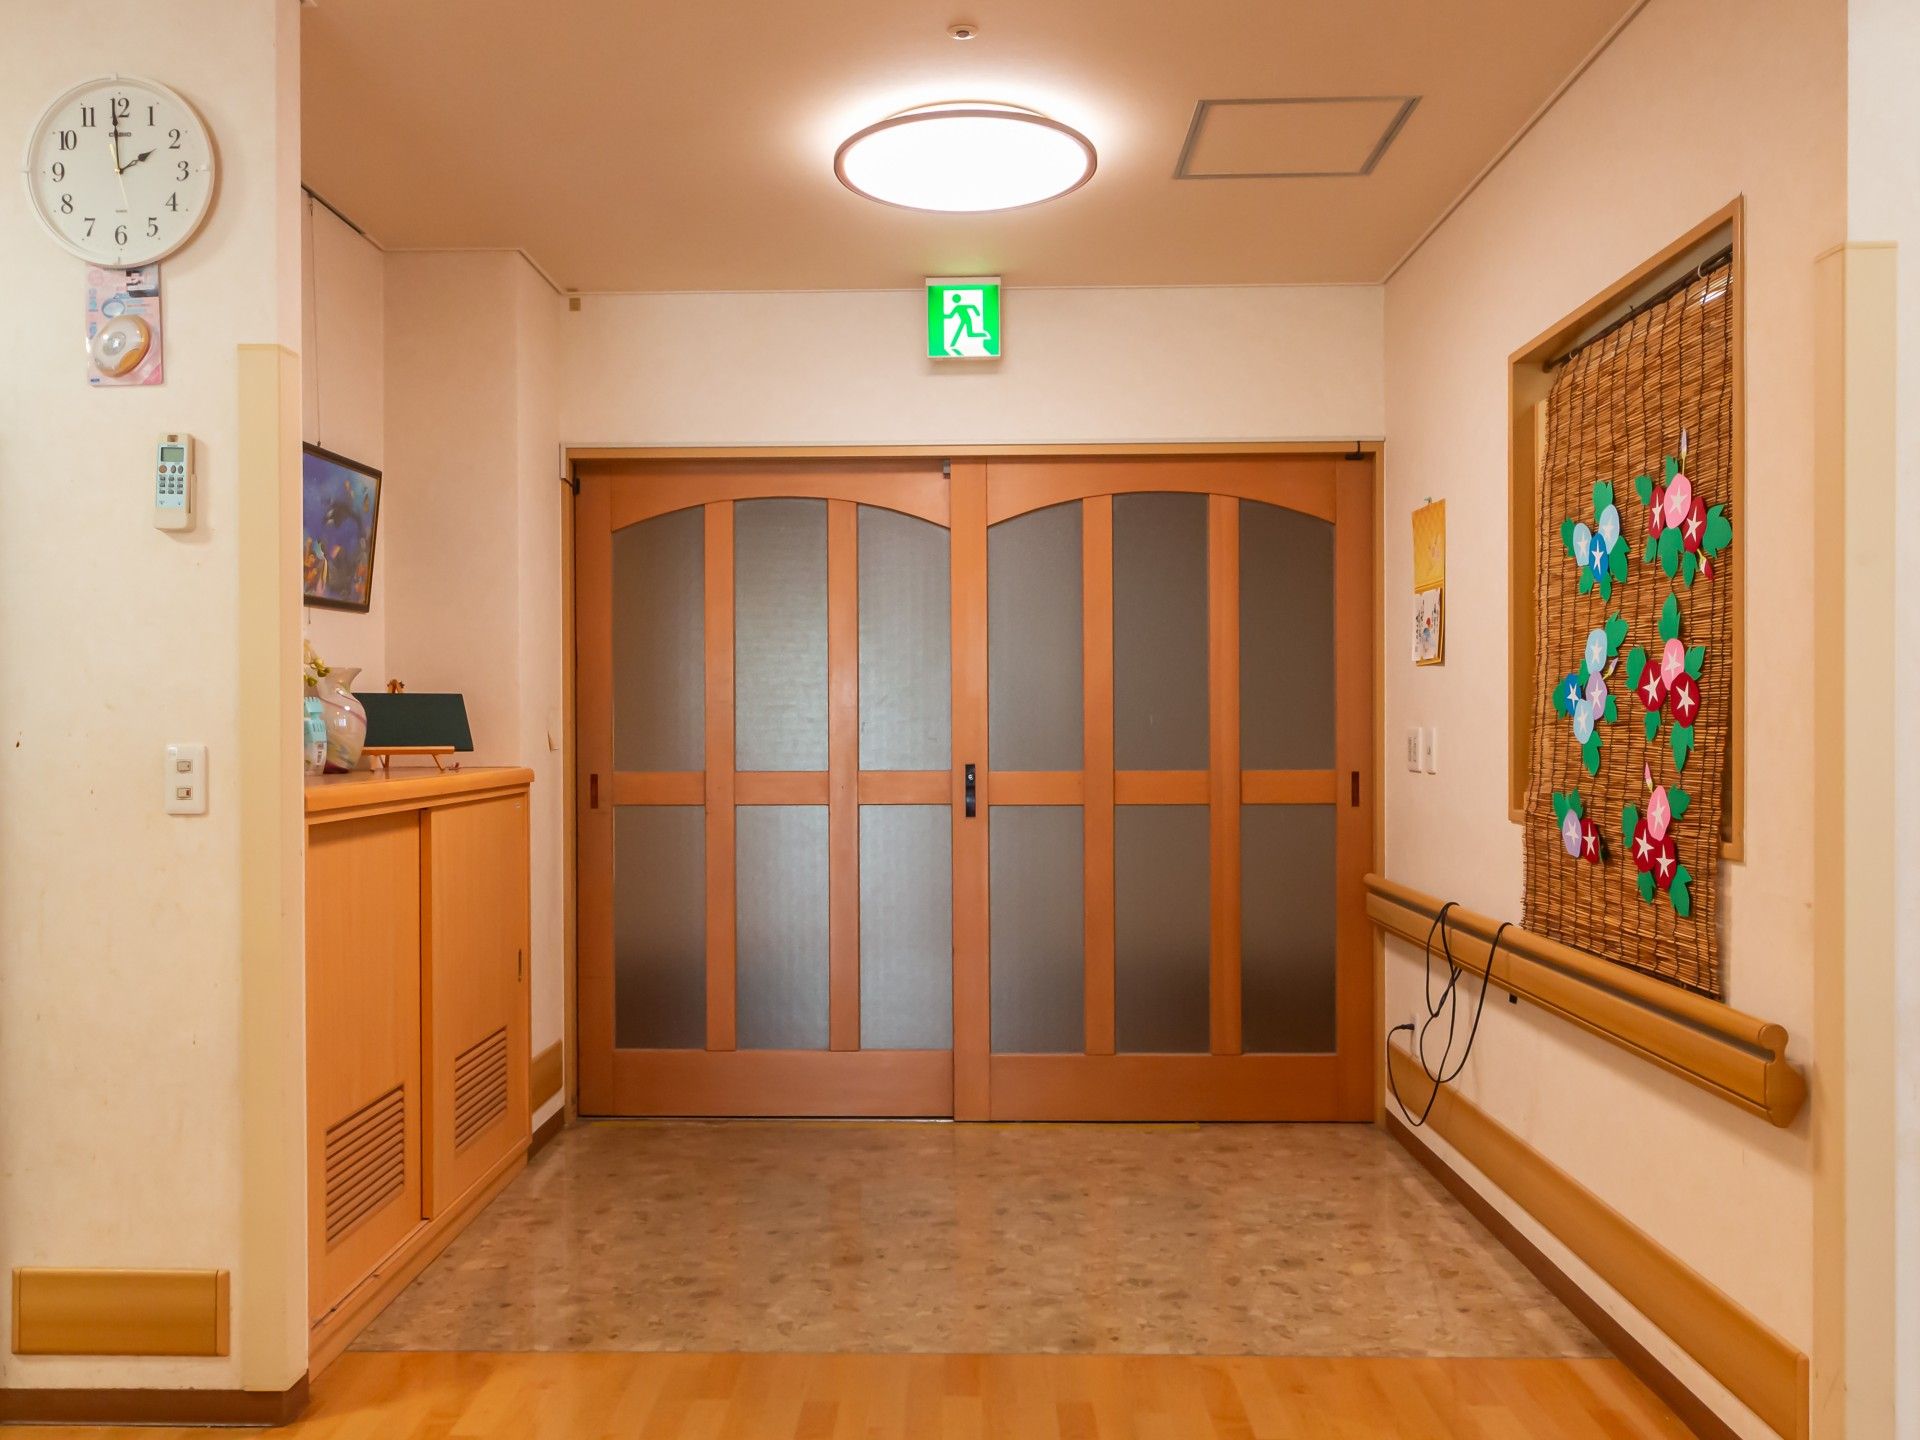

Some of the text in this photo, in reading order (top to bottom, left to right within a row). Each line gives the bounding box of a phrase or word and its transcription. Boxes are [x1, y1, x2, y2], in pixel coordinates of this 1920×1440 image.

[81, 106, 97, 128] 11
[110, 97, 130, 118] 12
[147, 105, 156, 127] 1
[59, 129, 78, 151] 10
[168, 128, 181, 150] 2
[52, 161, 66, 183] 9
[176, 160, 190, 182] 3
[60, 193, 74, 215] 8
[165, 192, 179, 212] 4
[84, 217, 96, 238] 7
[114, 225, 128, 246] 6
[146, 217, 159, 238] 5
